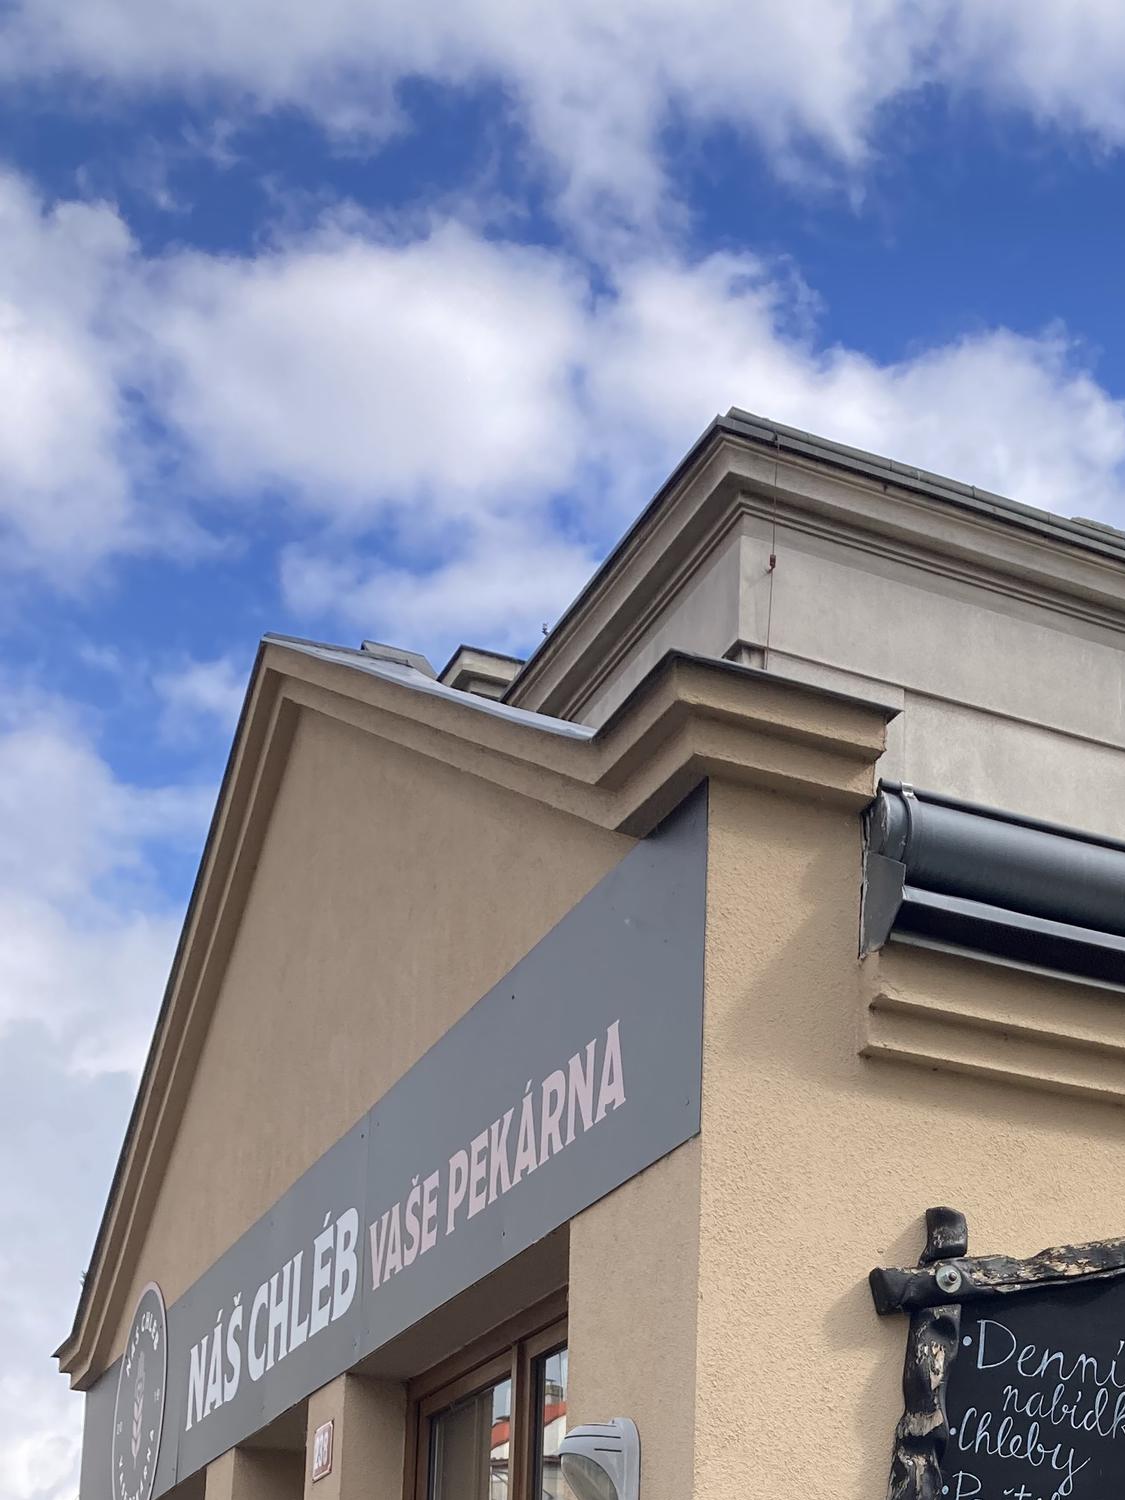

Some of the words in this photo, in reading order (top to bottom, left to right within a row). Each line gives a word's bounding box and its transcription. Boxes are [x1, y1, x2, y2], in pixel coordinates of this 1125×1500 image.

[186, 1292, 243, 1431] NÁŠ
[248, 1208, 359, 1381] CHLÉB
[369, 1170, 439, 1291] VAŠE
[445, 1019, 627, 1235] PEKÁRNA
[958, 1407, 1091, 1495] Chleby
